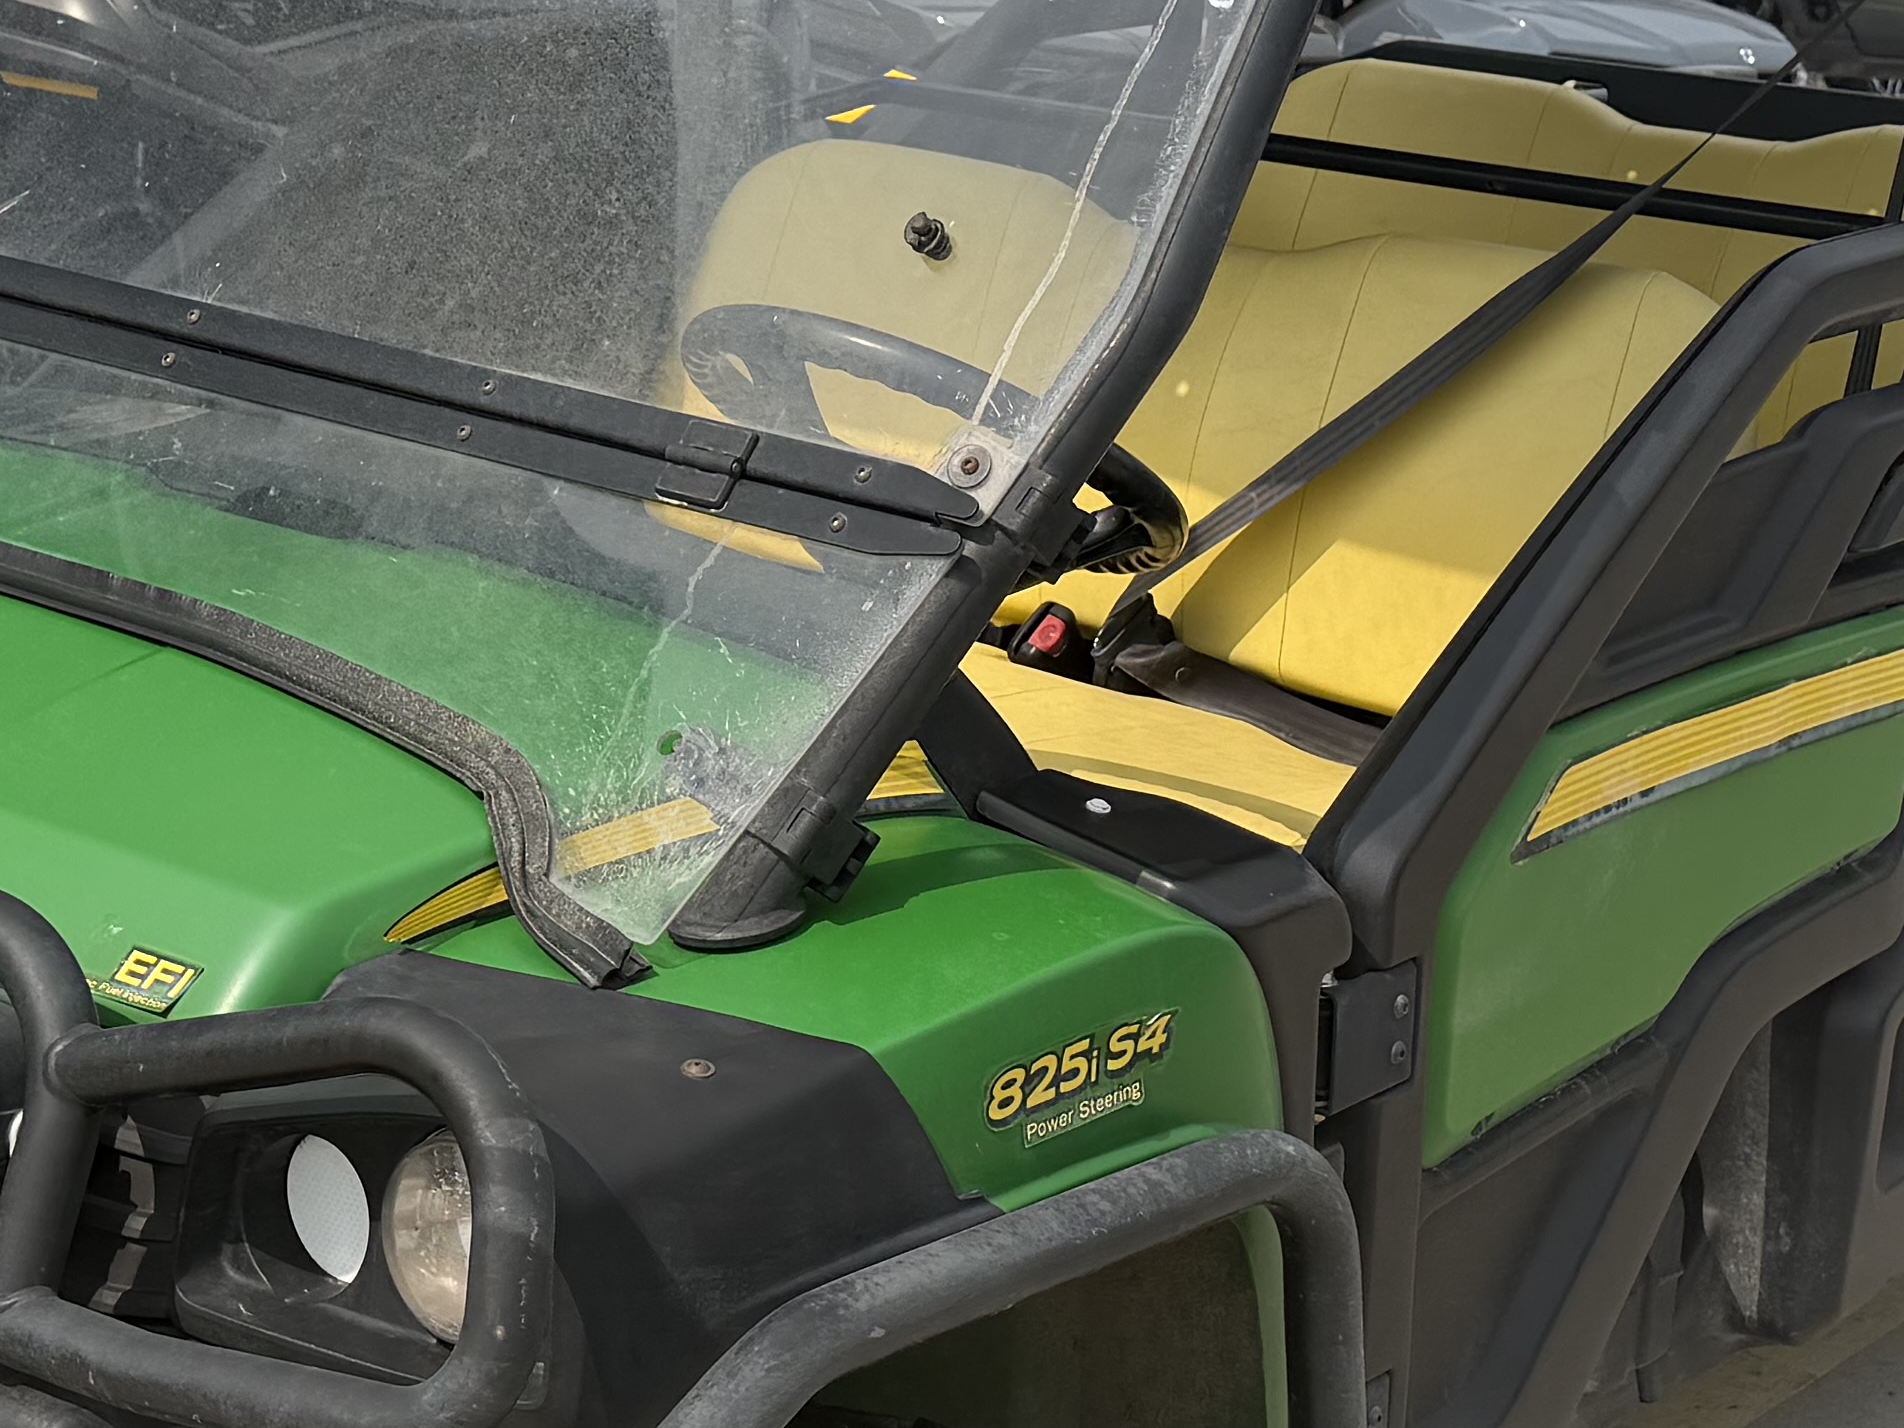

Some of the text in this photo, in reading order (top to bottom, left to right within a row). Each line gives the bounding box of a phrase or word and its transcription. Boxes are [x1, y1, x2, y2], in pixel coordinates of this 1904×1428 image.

[114, 949, 195, 999] EFI
[987, 1013, 1172, 1122] 825i S4
[1026, 1082, 1142, 1142] Power Steering
